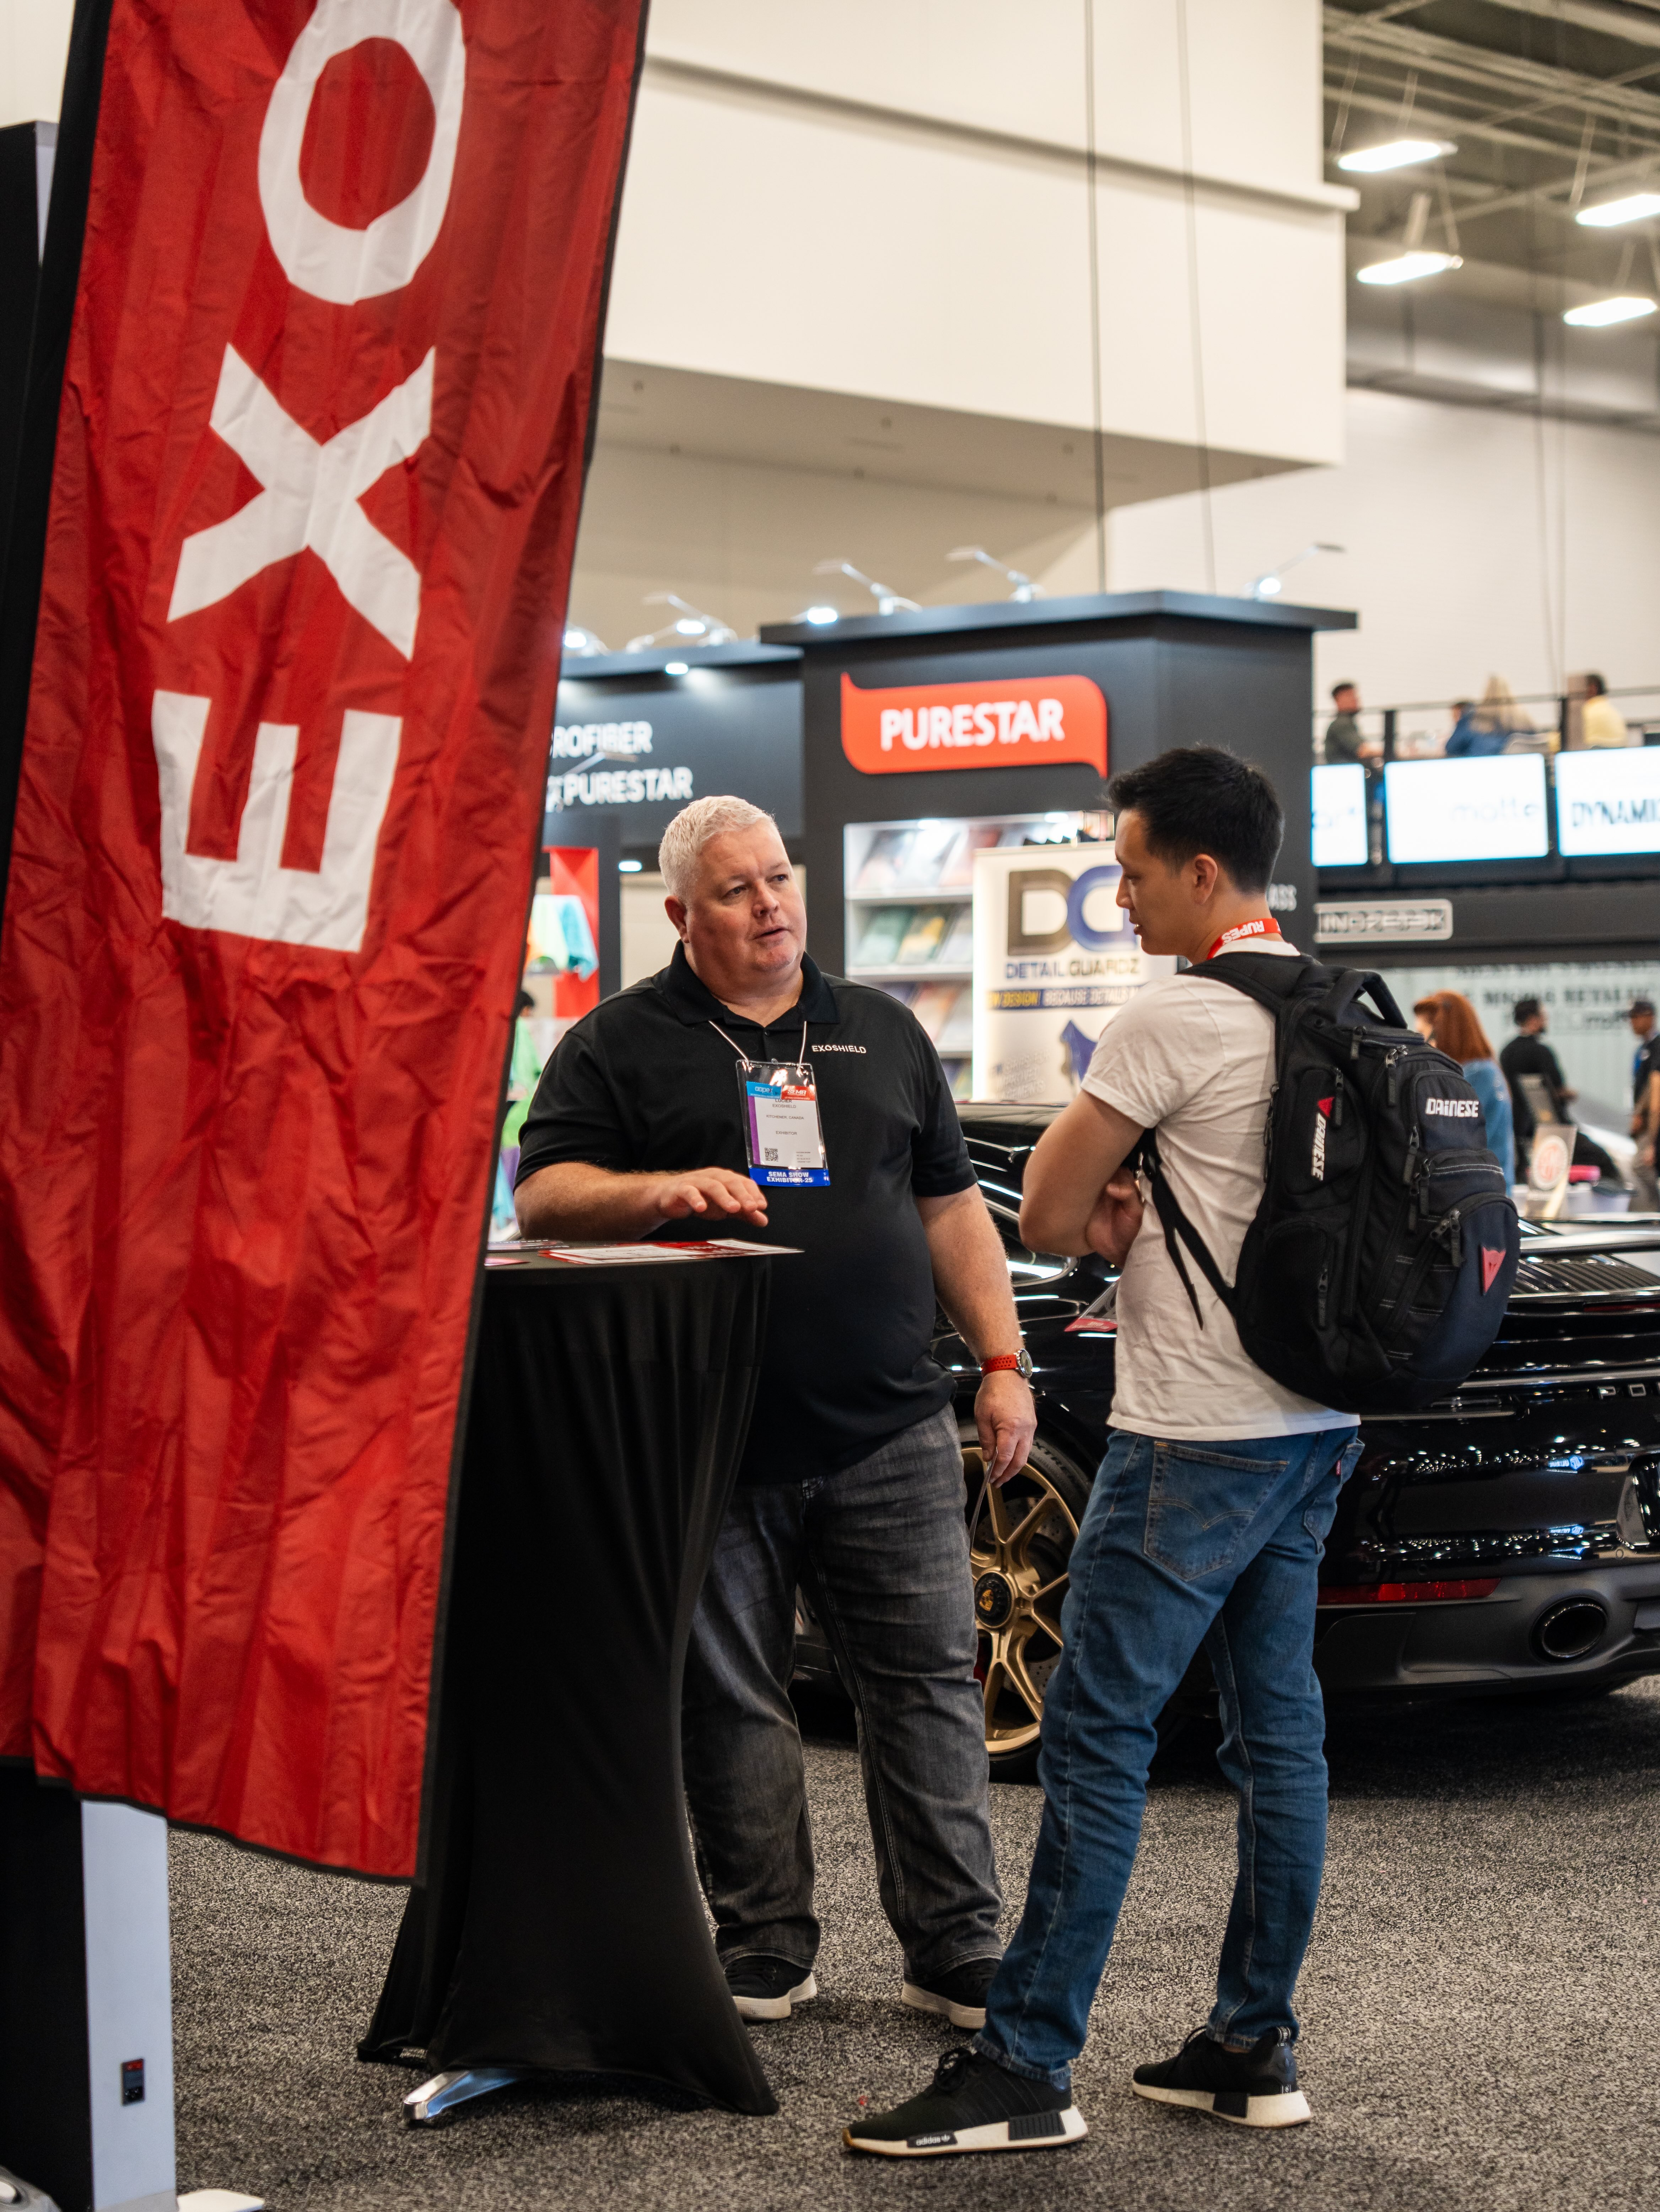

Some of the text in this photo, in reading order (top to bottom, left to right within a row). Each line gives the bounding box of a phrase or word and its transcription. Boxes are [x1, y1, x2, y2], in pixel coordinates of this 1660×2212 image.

[151, 0, 465, 952] EXO
[550, 721, 653, 758] ROFIBER
[880, 698, 1065, 751] PURESTAR
[563, 767, 694, 806] PURESTAR
[1222, 920, 1265, 943] RUPES
[1006, 959, 1140, 979] DETAIL GUARDZ
[812, 1045, 866, 1053] EXOSHIELD
[916, 2136, 941, 2146] adidas
